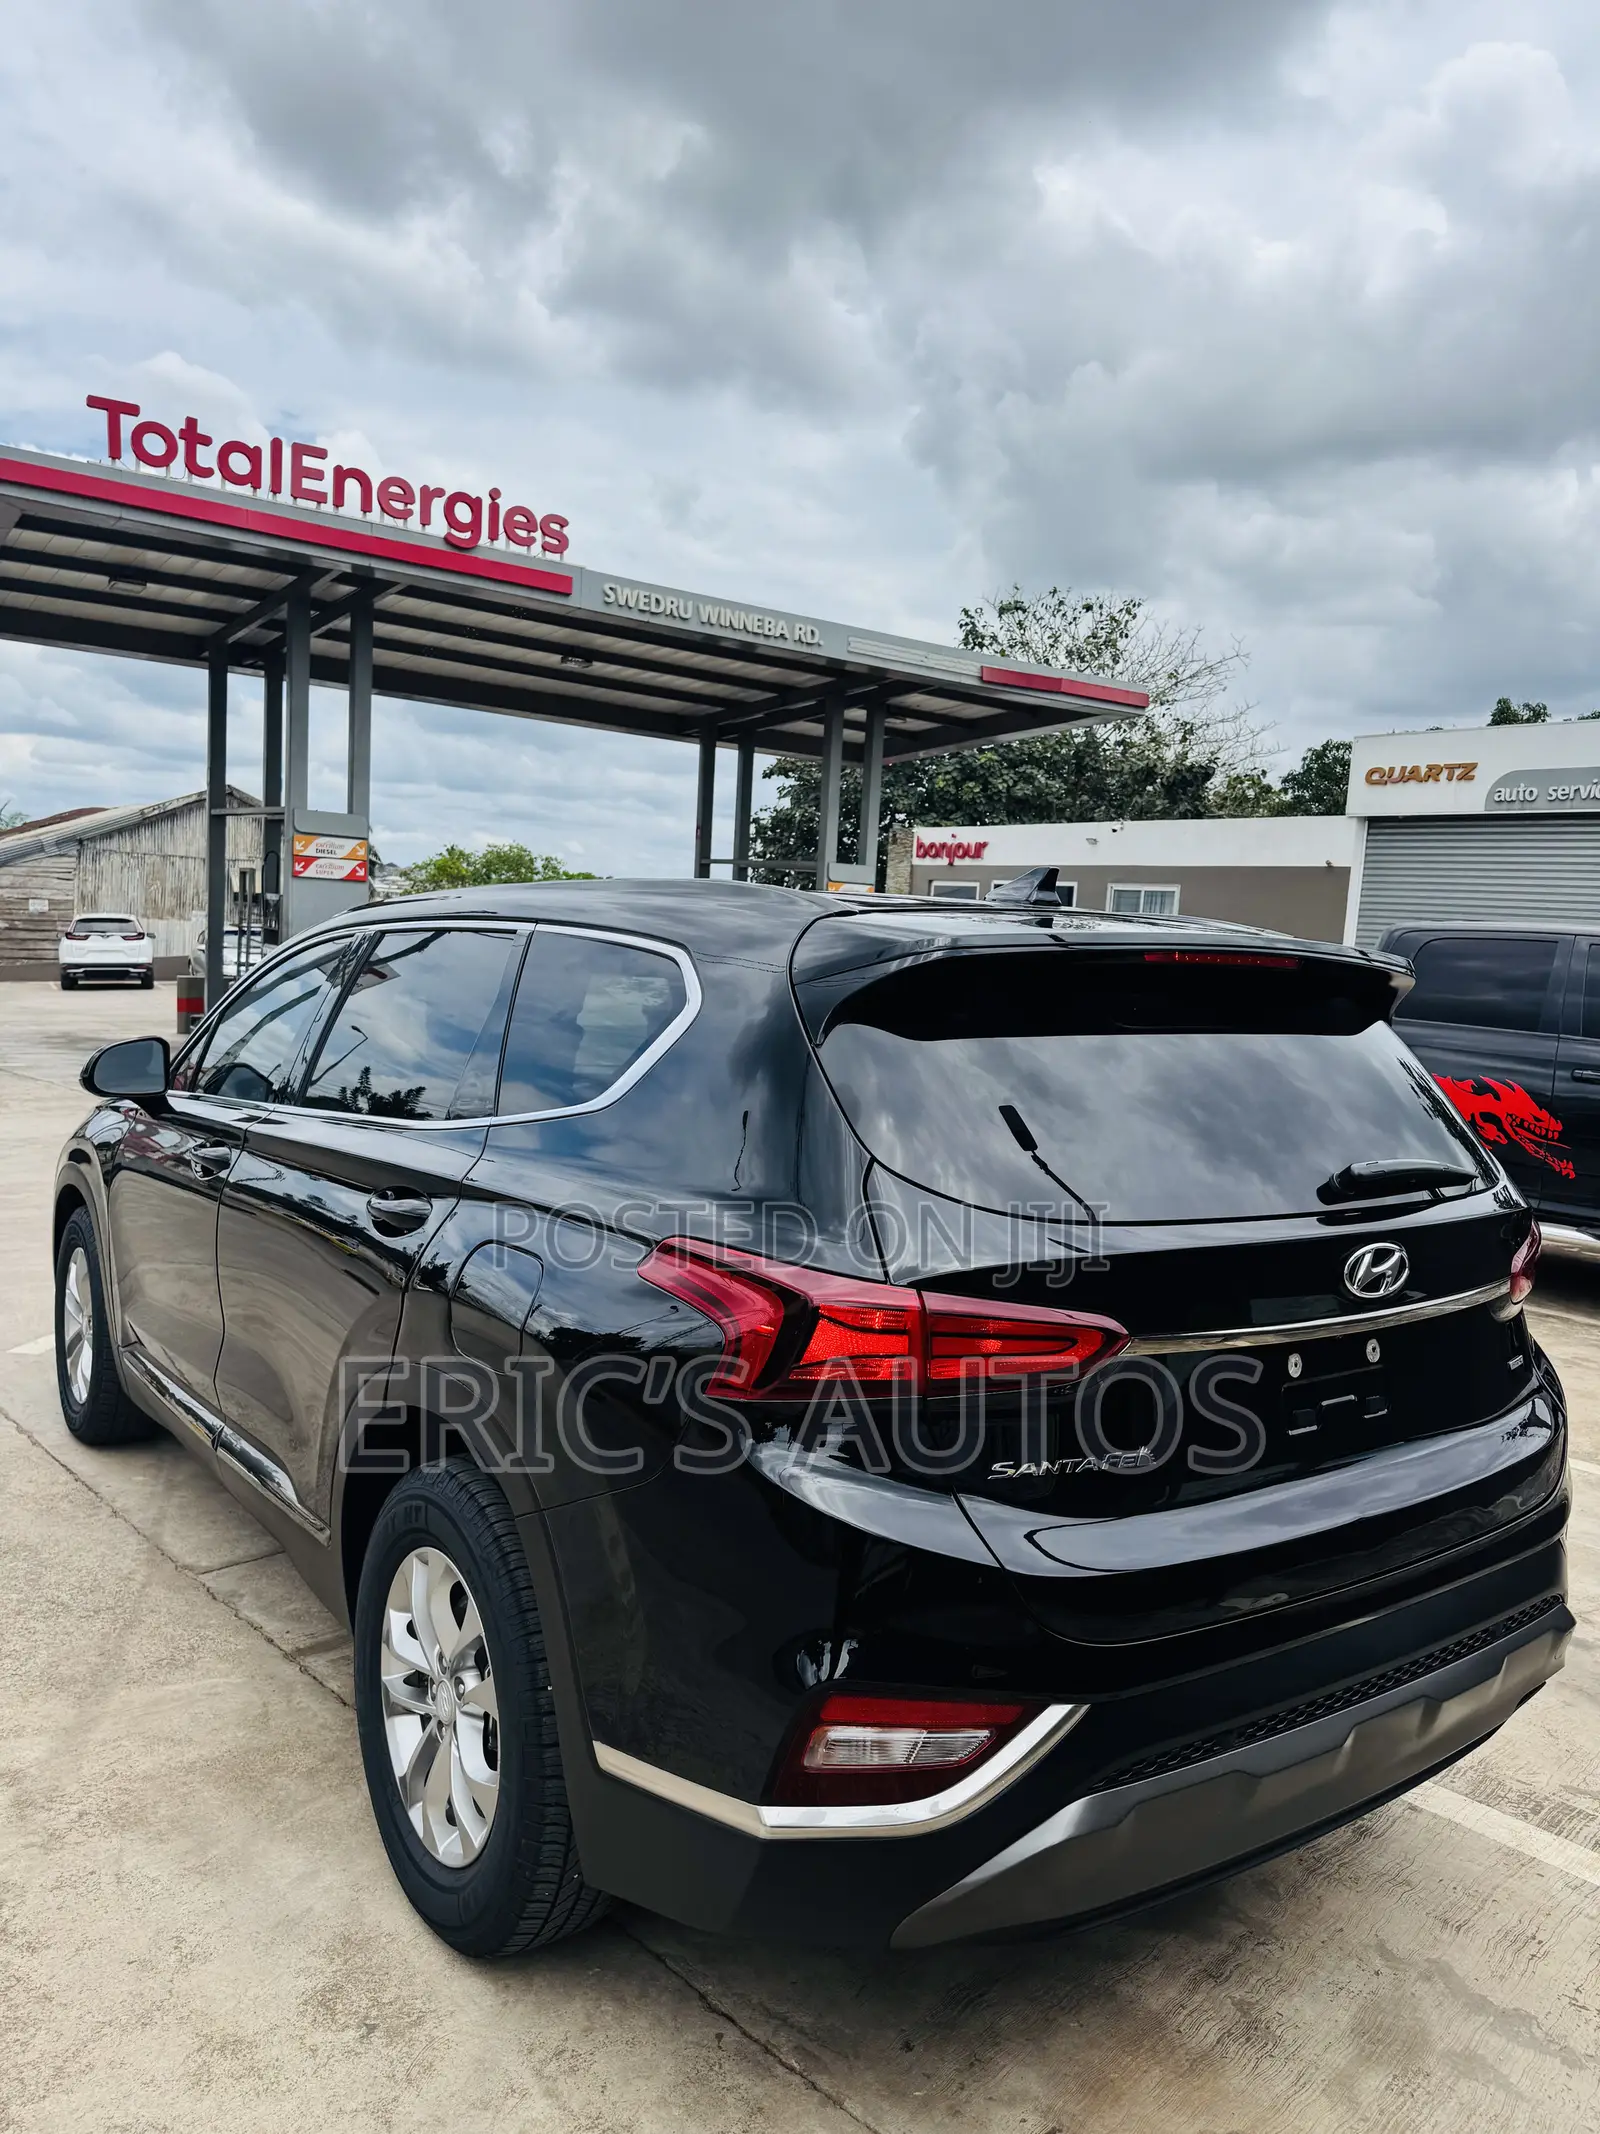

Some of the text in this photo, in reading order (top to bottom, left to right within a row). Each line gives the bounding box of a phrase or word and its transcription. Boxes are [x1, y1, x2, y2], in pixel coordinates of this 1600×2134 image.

[86, 394, 571, 553] TotalEnergies
[602, 582, 824, 646] SWEDRU WINNEBA RD.
[1365, 762, 1478, 785] QUARTZ
[1493, 782, 1538, 802] auto
[315, 848, 337, 856] DIESEL
[915, 834, 989, 866] bonjour
[987, 1456, 1099, 1480] SANTA
